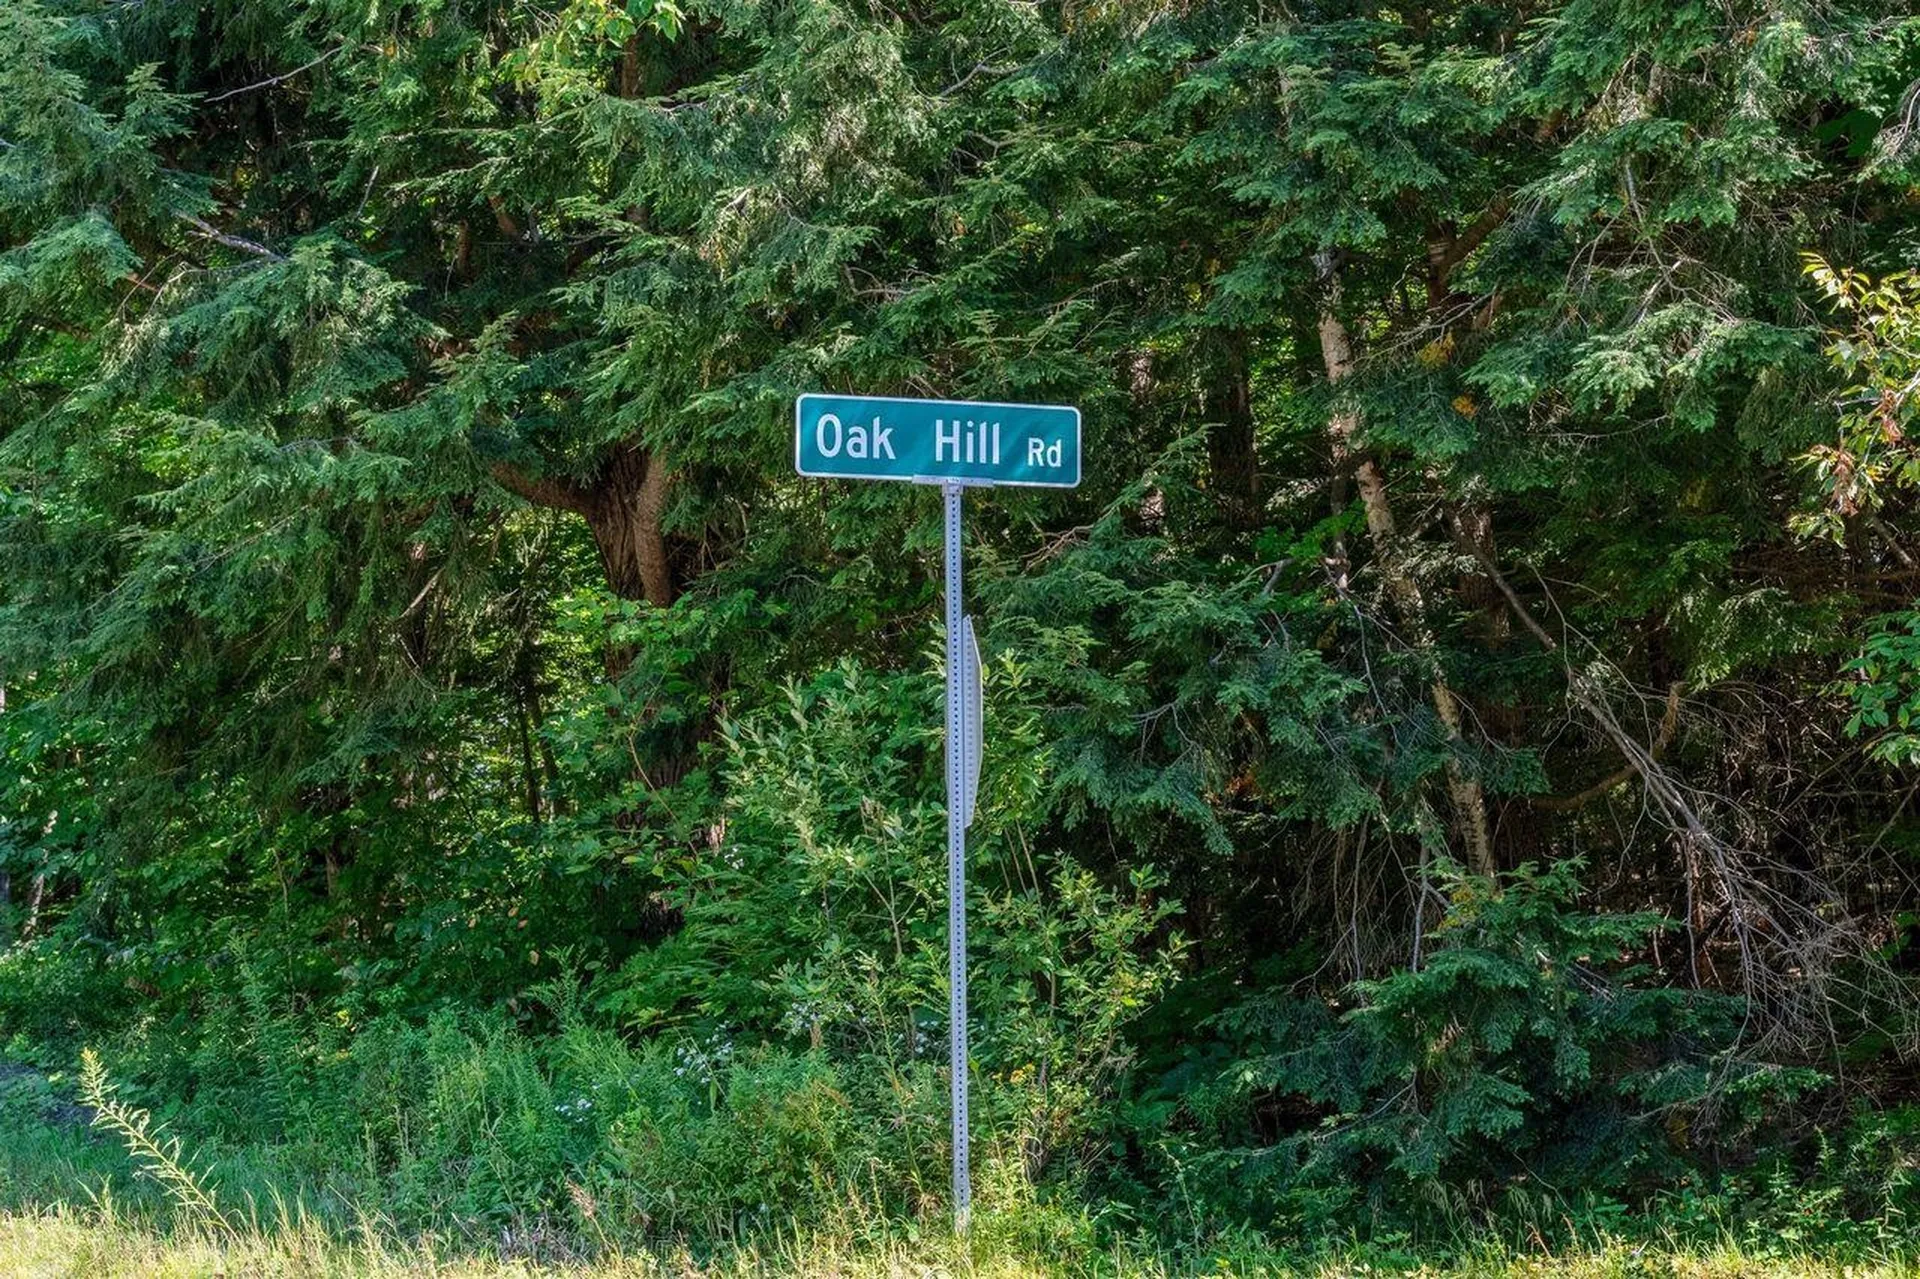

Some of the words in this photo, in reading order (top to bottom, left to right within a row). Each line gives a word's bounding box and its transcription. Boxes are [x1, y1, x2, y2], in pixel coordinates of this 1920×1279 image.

[816, 413, 896, 460] Oak
[935, 419, 1001, 465] Hill
[1027, 437, 1062, 468] Rd
